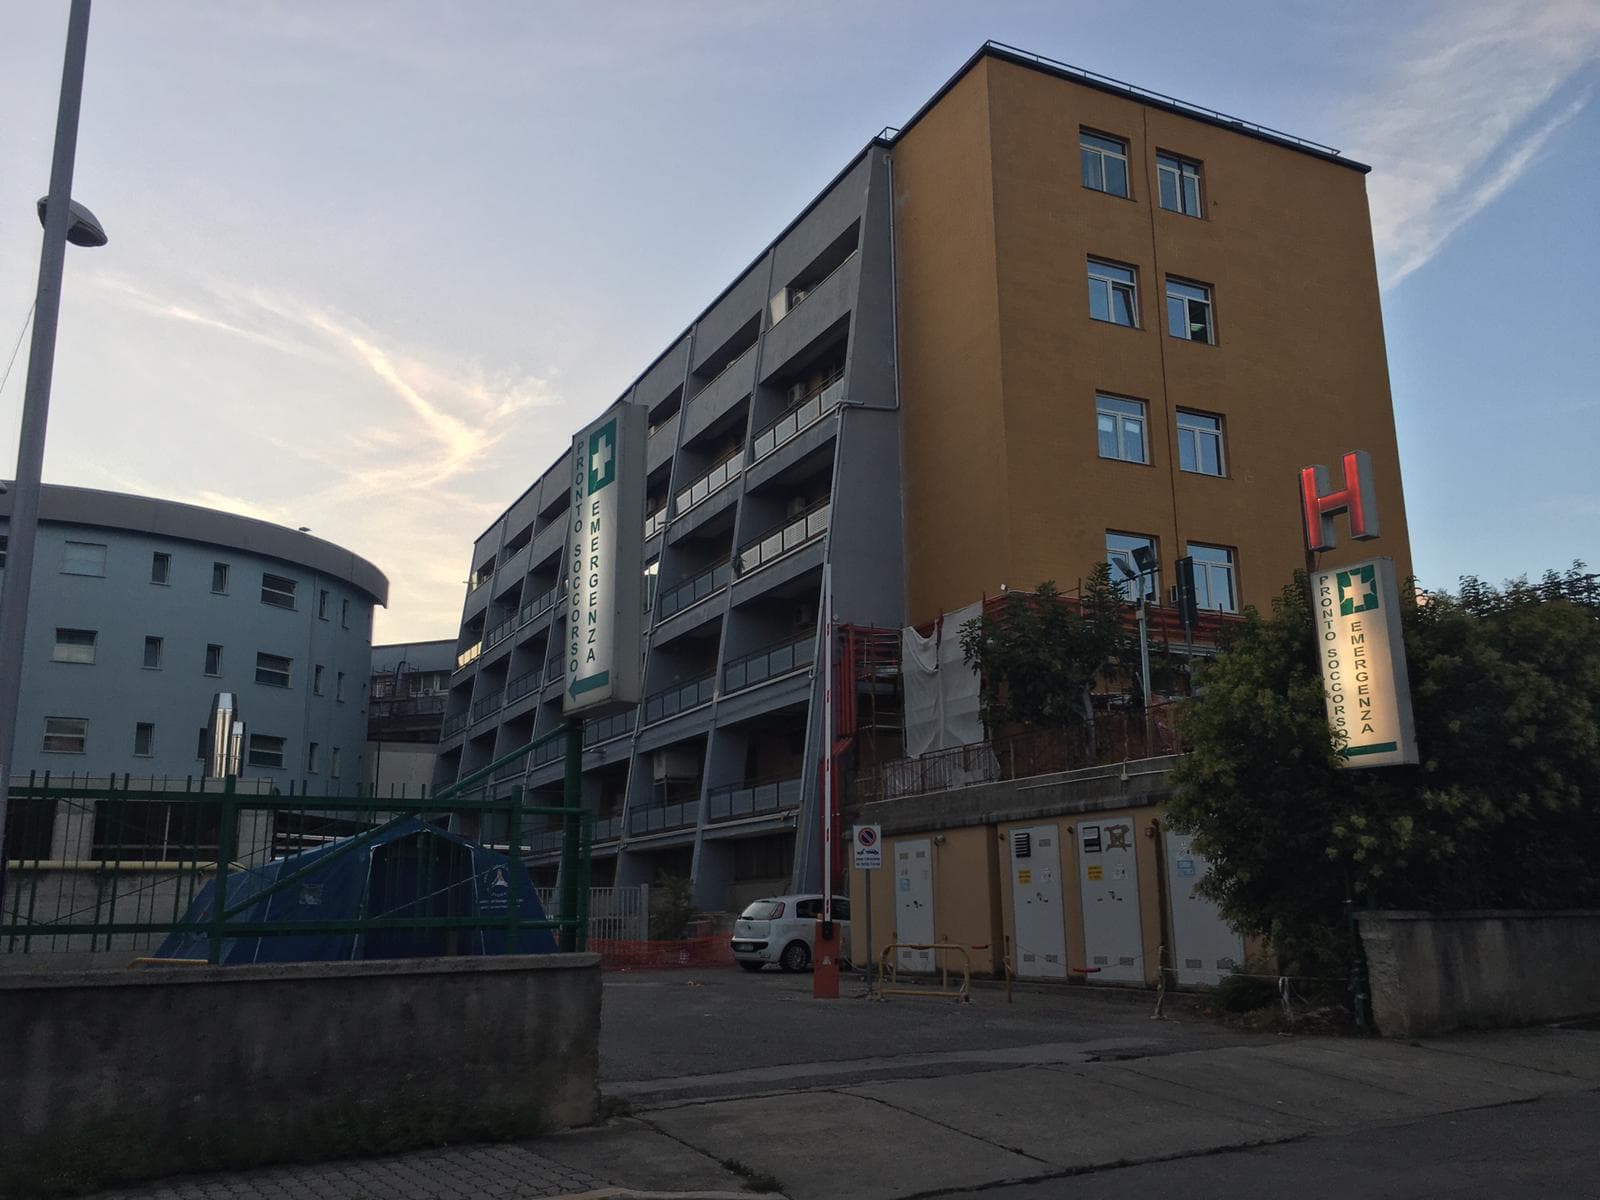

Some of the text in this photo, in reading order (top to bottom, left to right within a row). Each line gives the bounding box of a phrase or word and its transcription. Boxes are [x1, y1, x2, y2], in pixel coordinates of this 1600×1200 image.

[570, 441, 584, 673] PRONTO SOCCORSO
[1301, 452, 1365, 549] H
[586, 500, 601, 664] EMERGENZA
[1319, 575, 1337, 641] PRONTO
[1350, 621, 1375, 734] EMERGENZA
